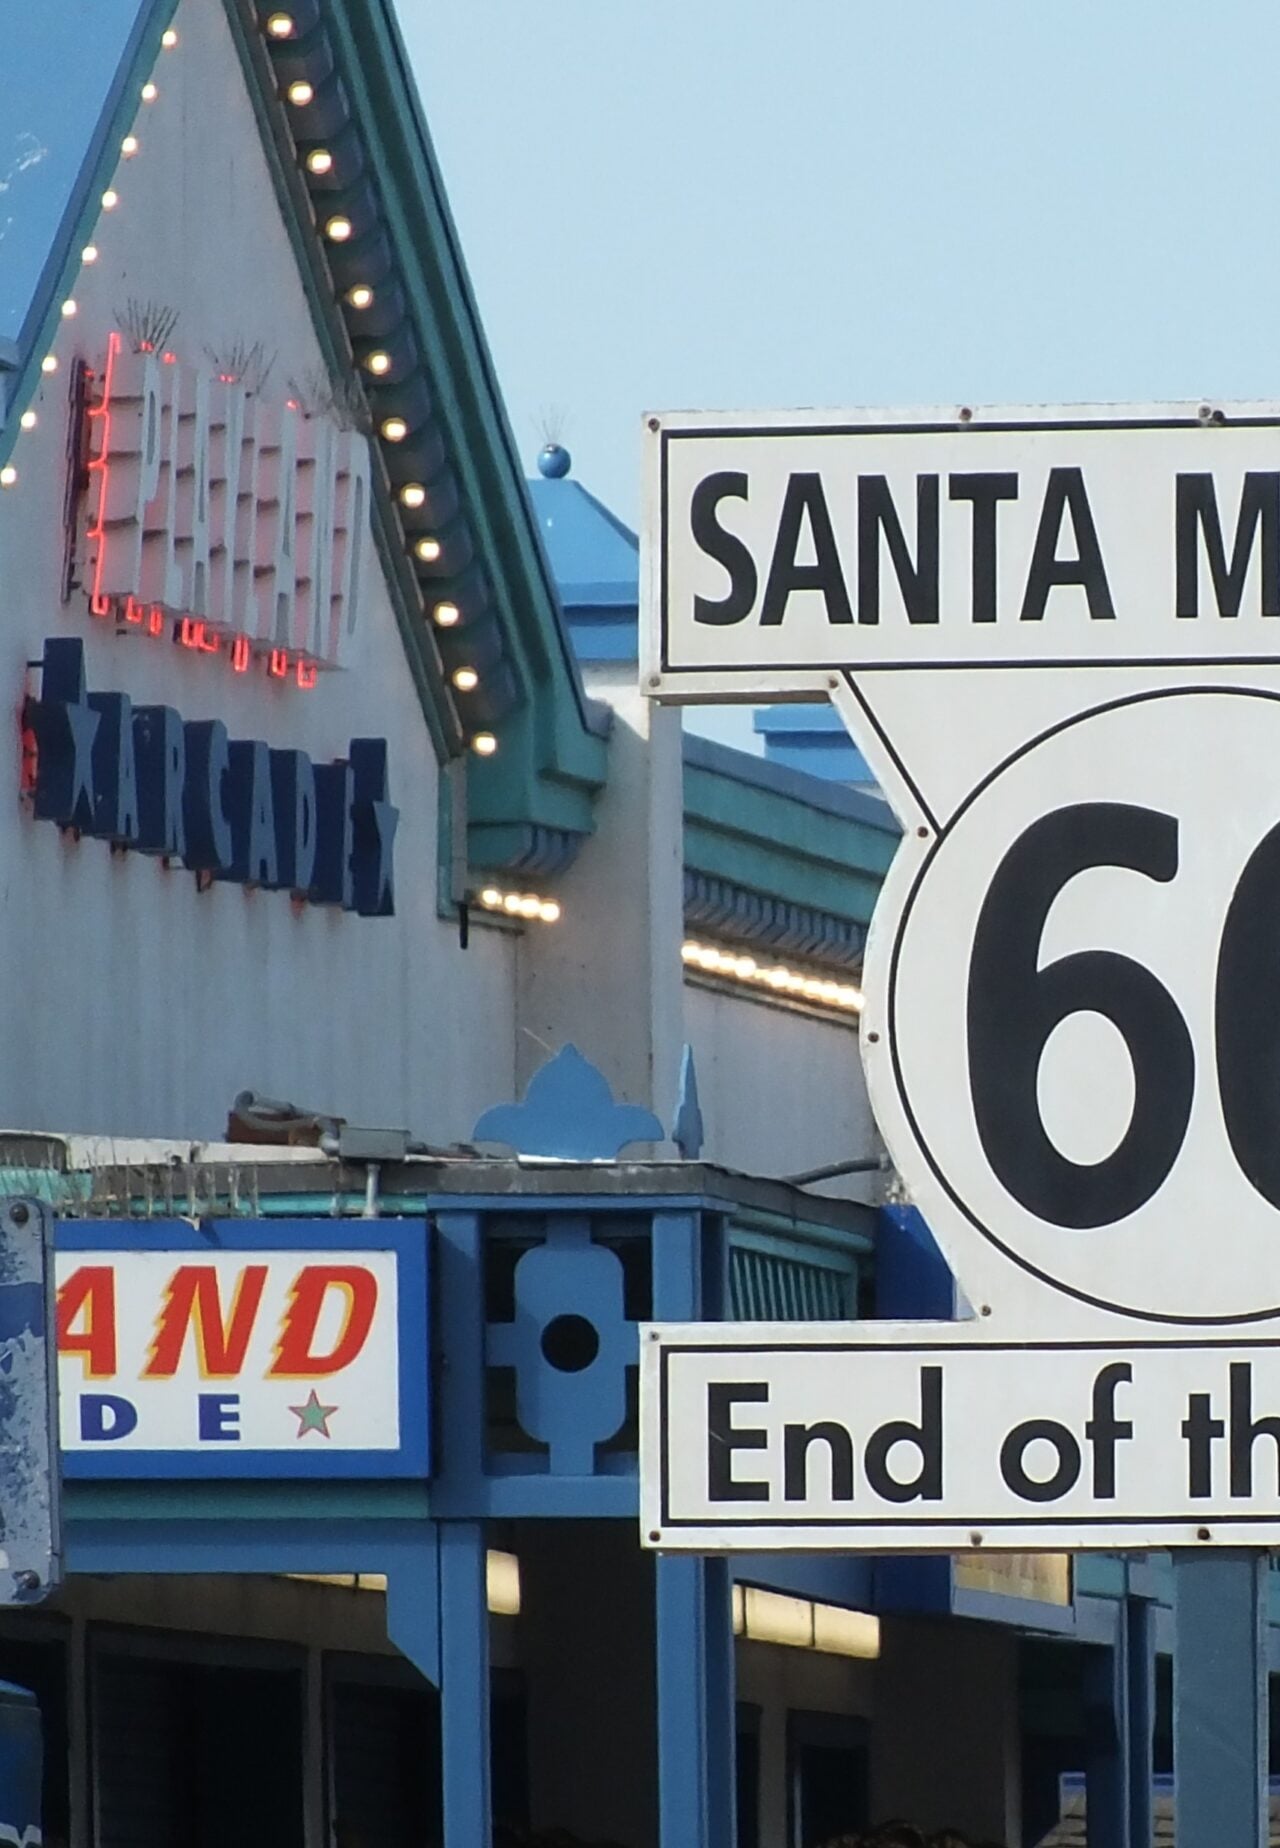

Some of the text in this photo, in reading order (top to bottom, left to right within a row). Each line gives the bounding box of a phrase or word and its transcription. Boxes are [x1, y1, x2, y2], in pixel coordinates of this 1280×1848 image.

[690, 466, 1117, 627] SANTA
[112, 690, 356, 912] ARCADE
[706, 1365, 944, 1503] End
[999, 1361, 1134, 1502] of
